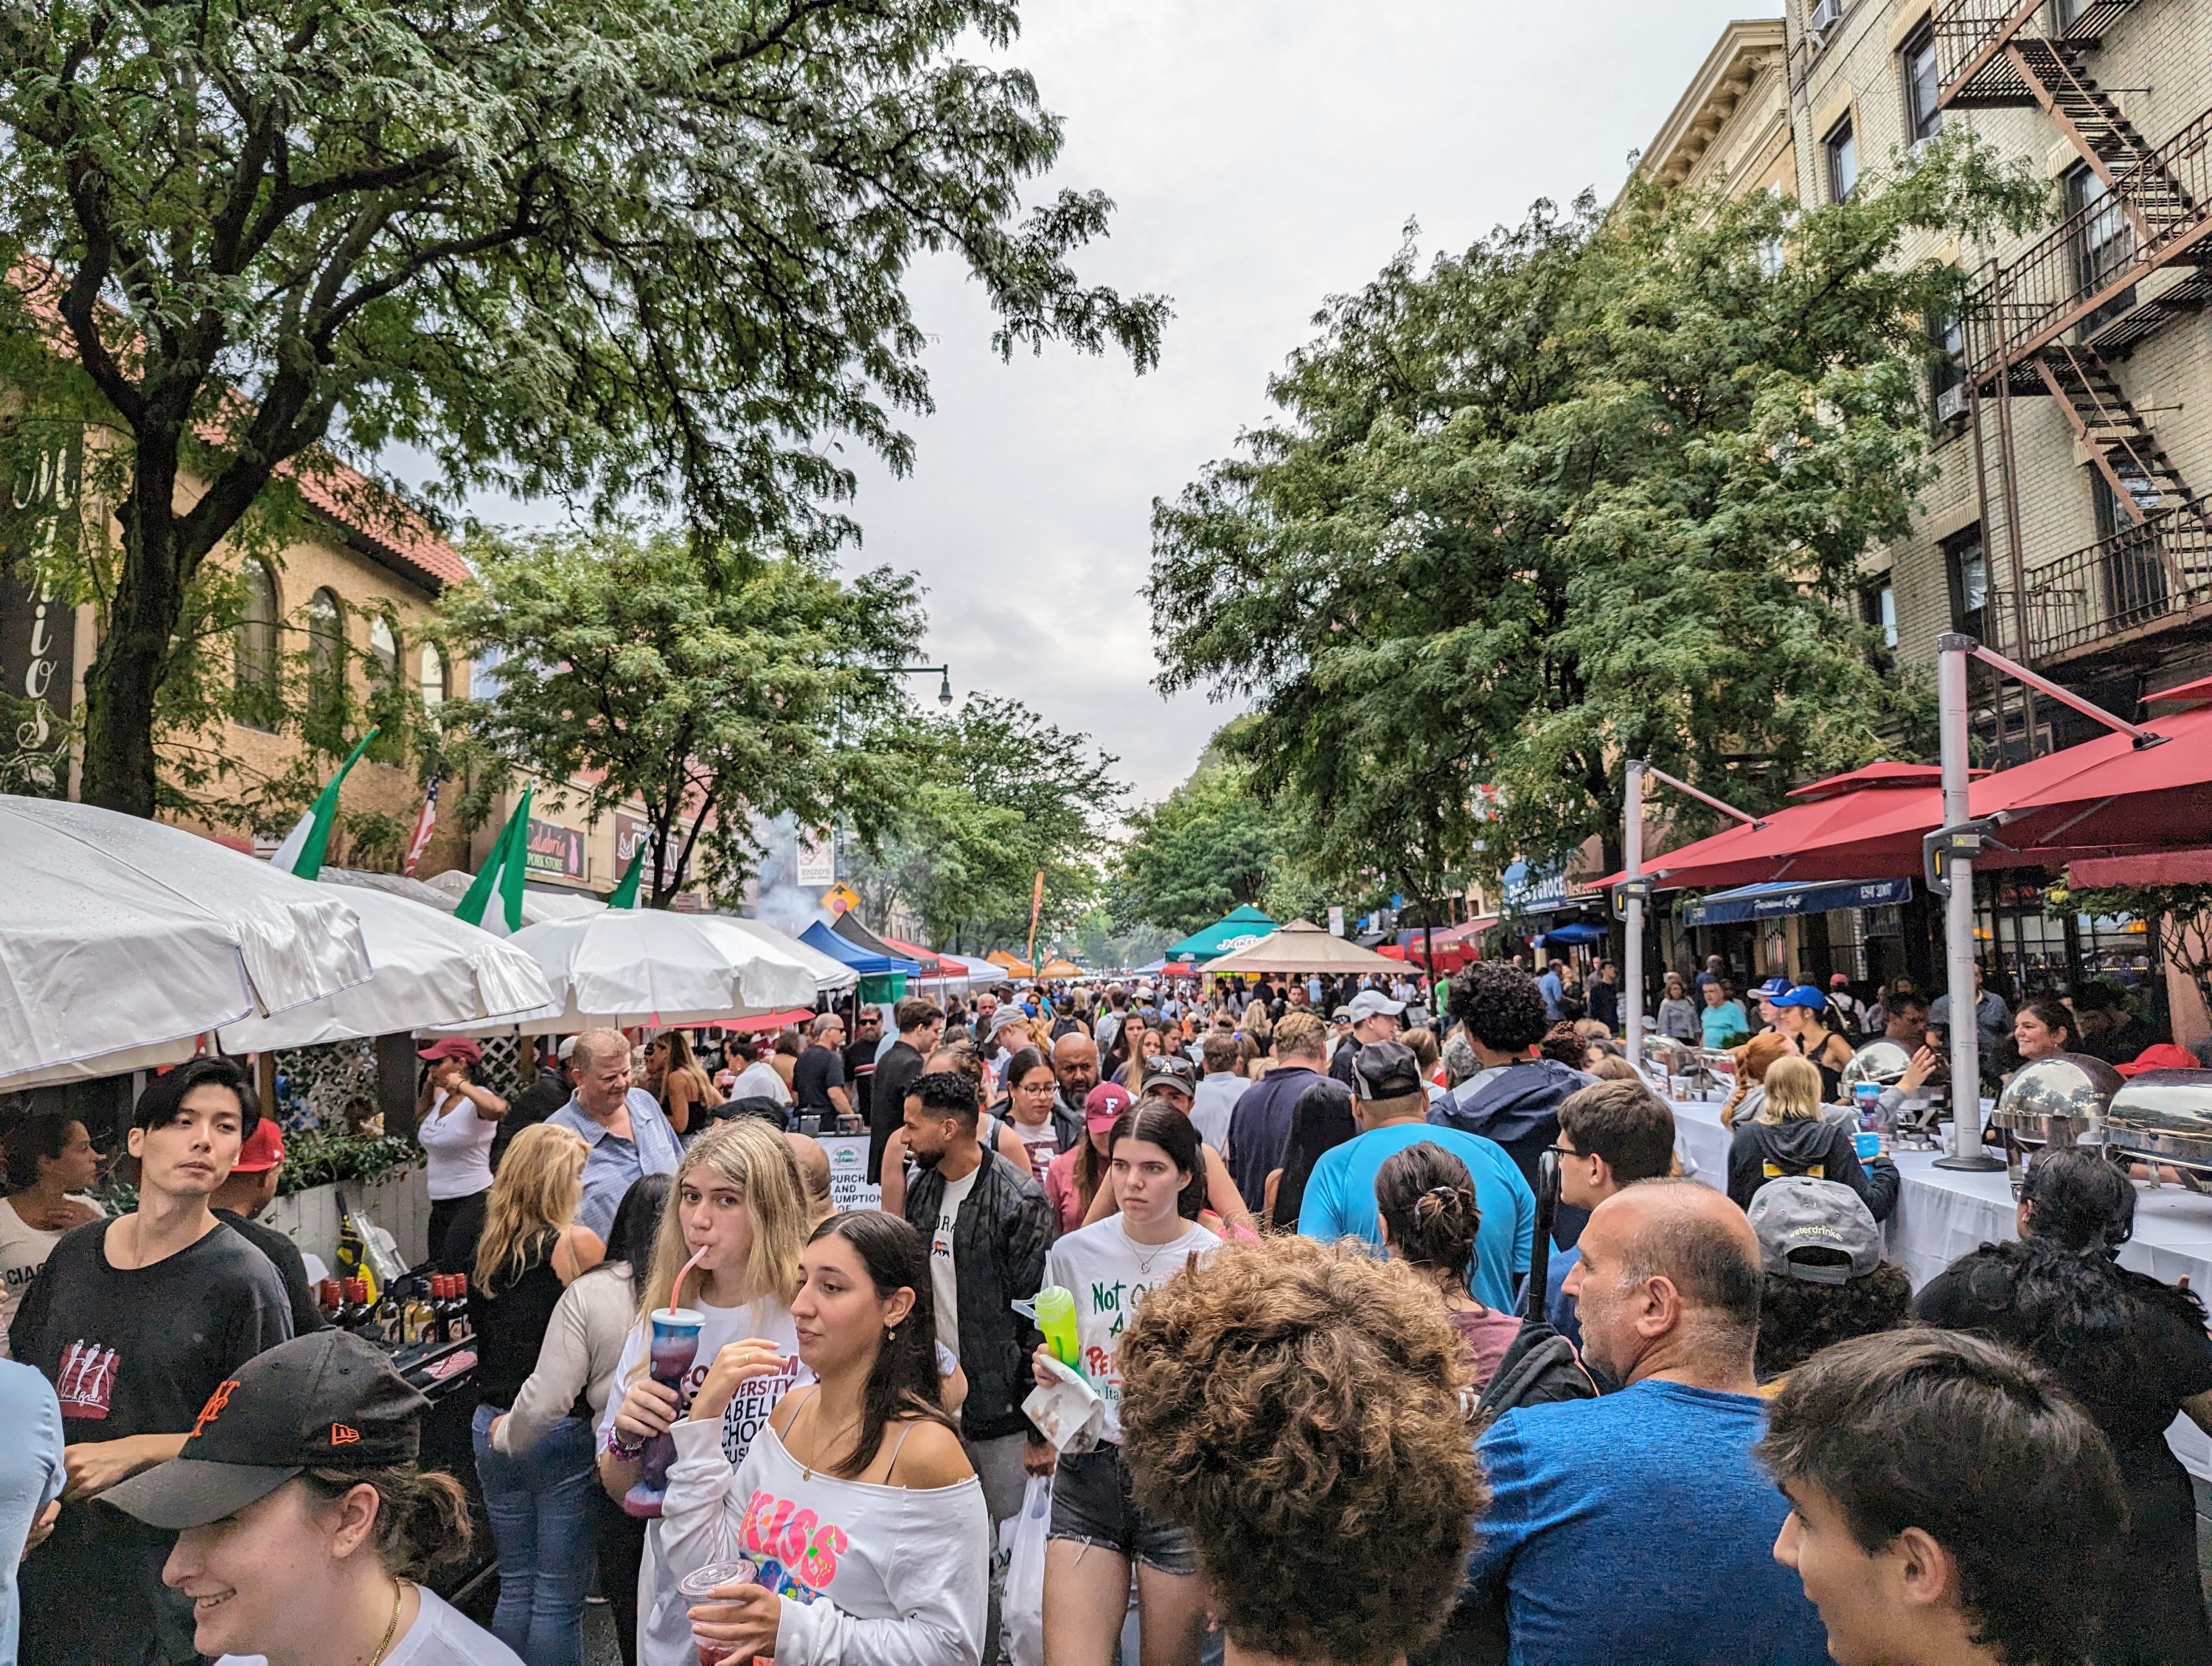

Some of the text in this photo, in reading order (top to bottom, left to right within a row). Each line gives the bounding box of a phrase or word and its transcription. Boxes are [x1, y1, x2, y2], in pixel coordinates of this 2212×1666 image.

[526, 853, 564, 872] PORK STORE
[1105, 1097, 1119, 1114] F
[831, 1174, 868, 1184] PURCH
[834, 1184, 856, 1193] AND
[832, 1193, 882, 1204] UMPTION
[738, 1488, 849, 1589] KISS
